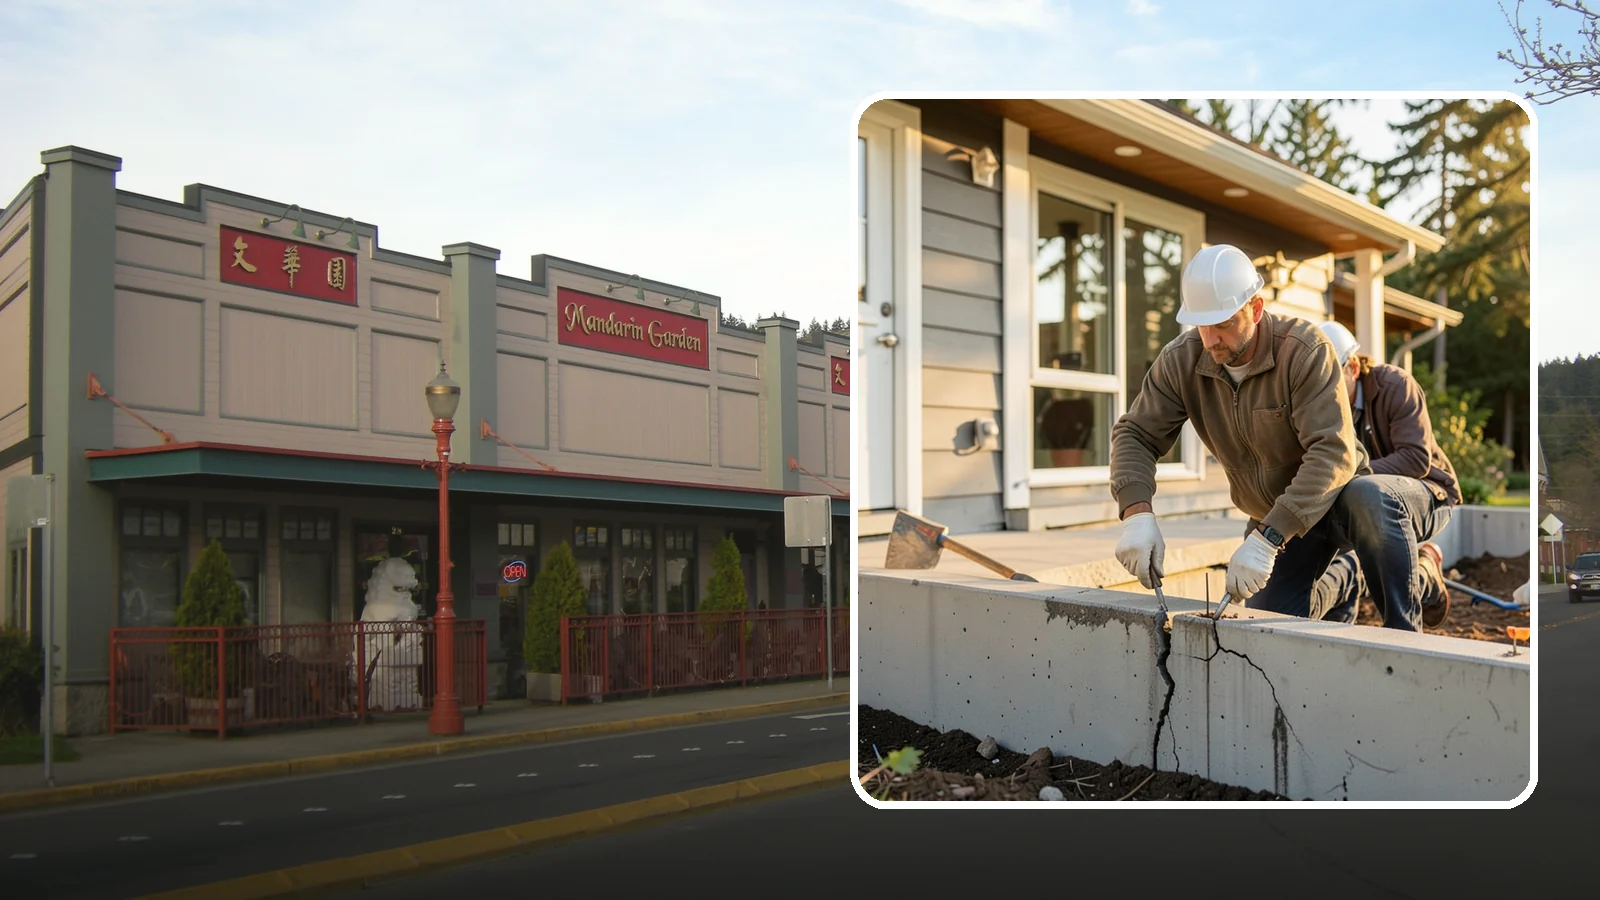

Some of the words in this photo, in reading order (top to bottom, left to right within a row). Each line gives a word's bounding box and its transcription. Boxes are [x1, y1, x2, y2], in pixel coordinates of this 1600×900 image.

[564, 302, 644, 341] Mandarin
[648, 320, 702, 352] Garden
[503, 565, 527, 578] OPEN
